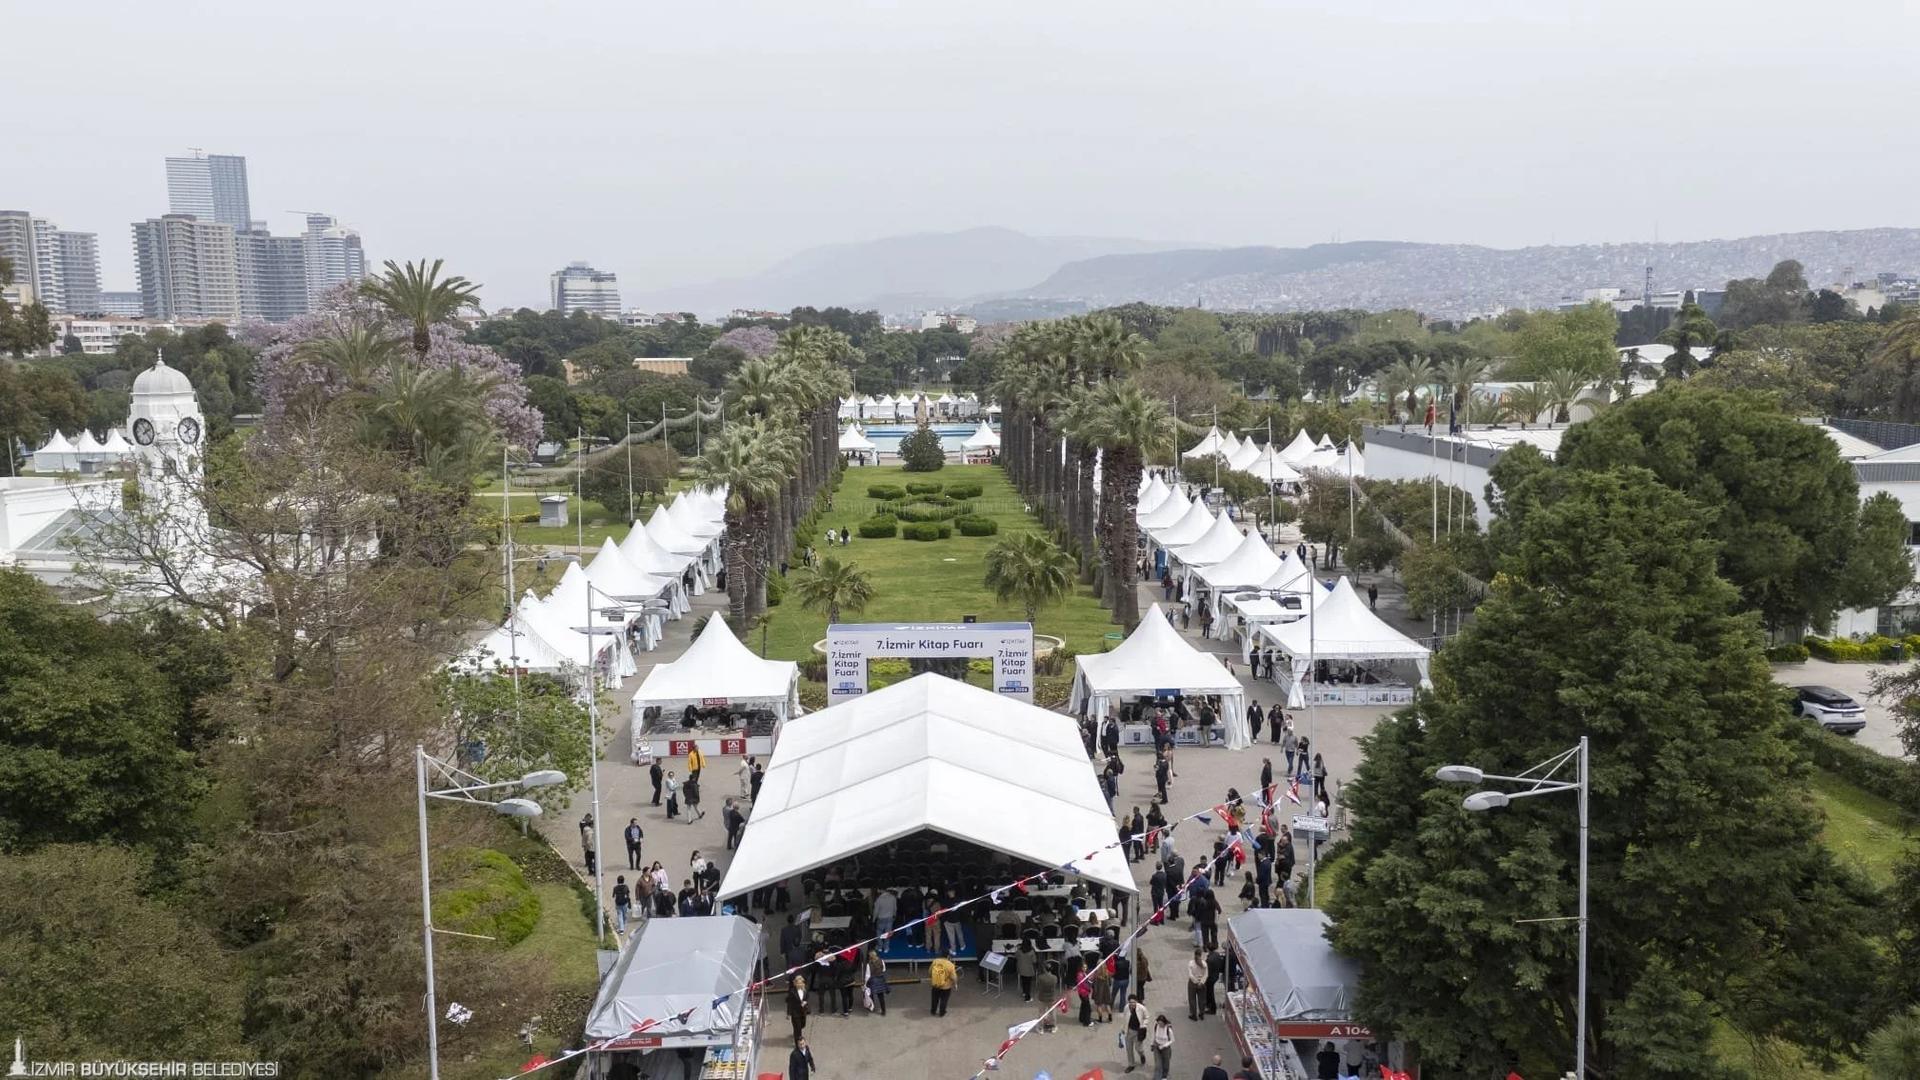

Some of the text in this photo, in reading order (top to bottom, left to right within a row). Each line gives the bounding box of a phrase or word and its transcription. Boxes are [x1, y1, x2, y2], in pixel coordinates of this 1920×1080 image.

[919, 639, 950, 651] Kitap
[953, 639, 983, 649] Fuarı
[834, 660, 859, 669] Kitap
[1001, 658, 1026, 667] Kitap
[1330, 1026, 1370, 1035] A 104
